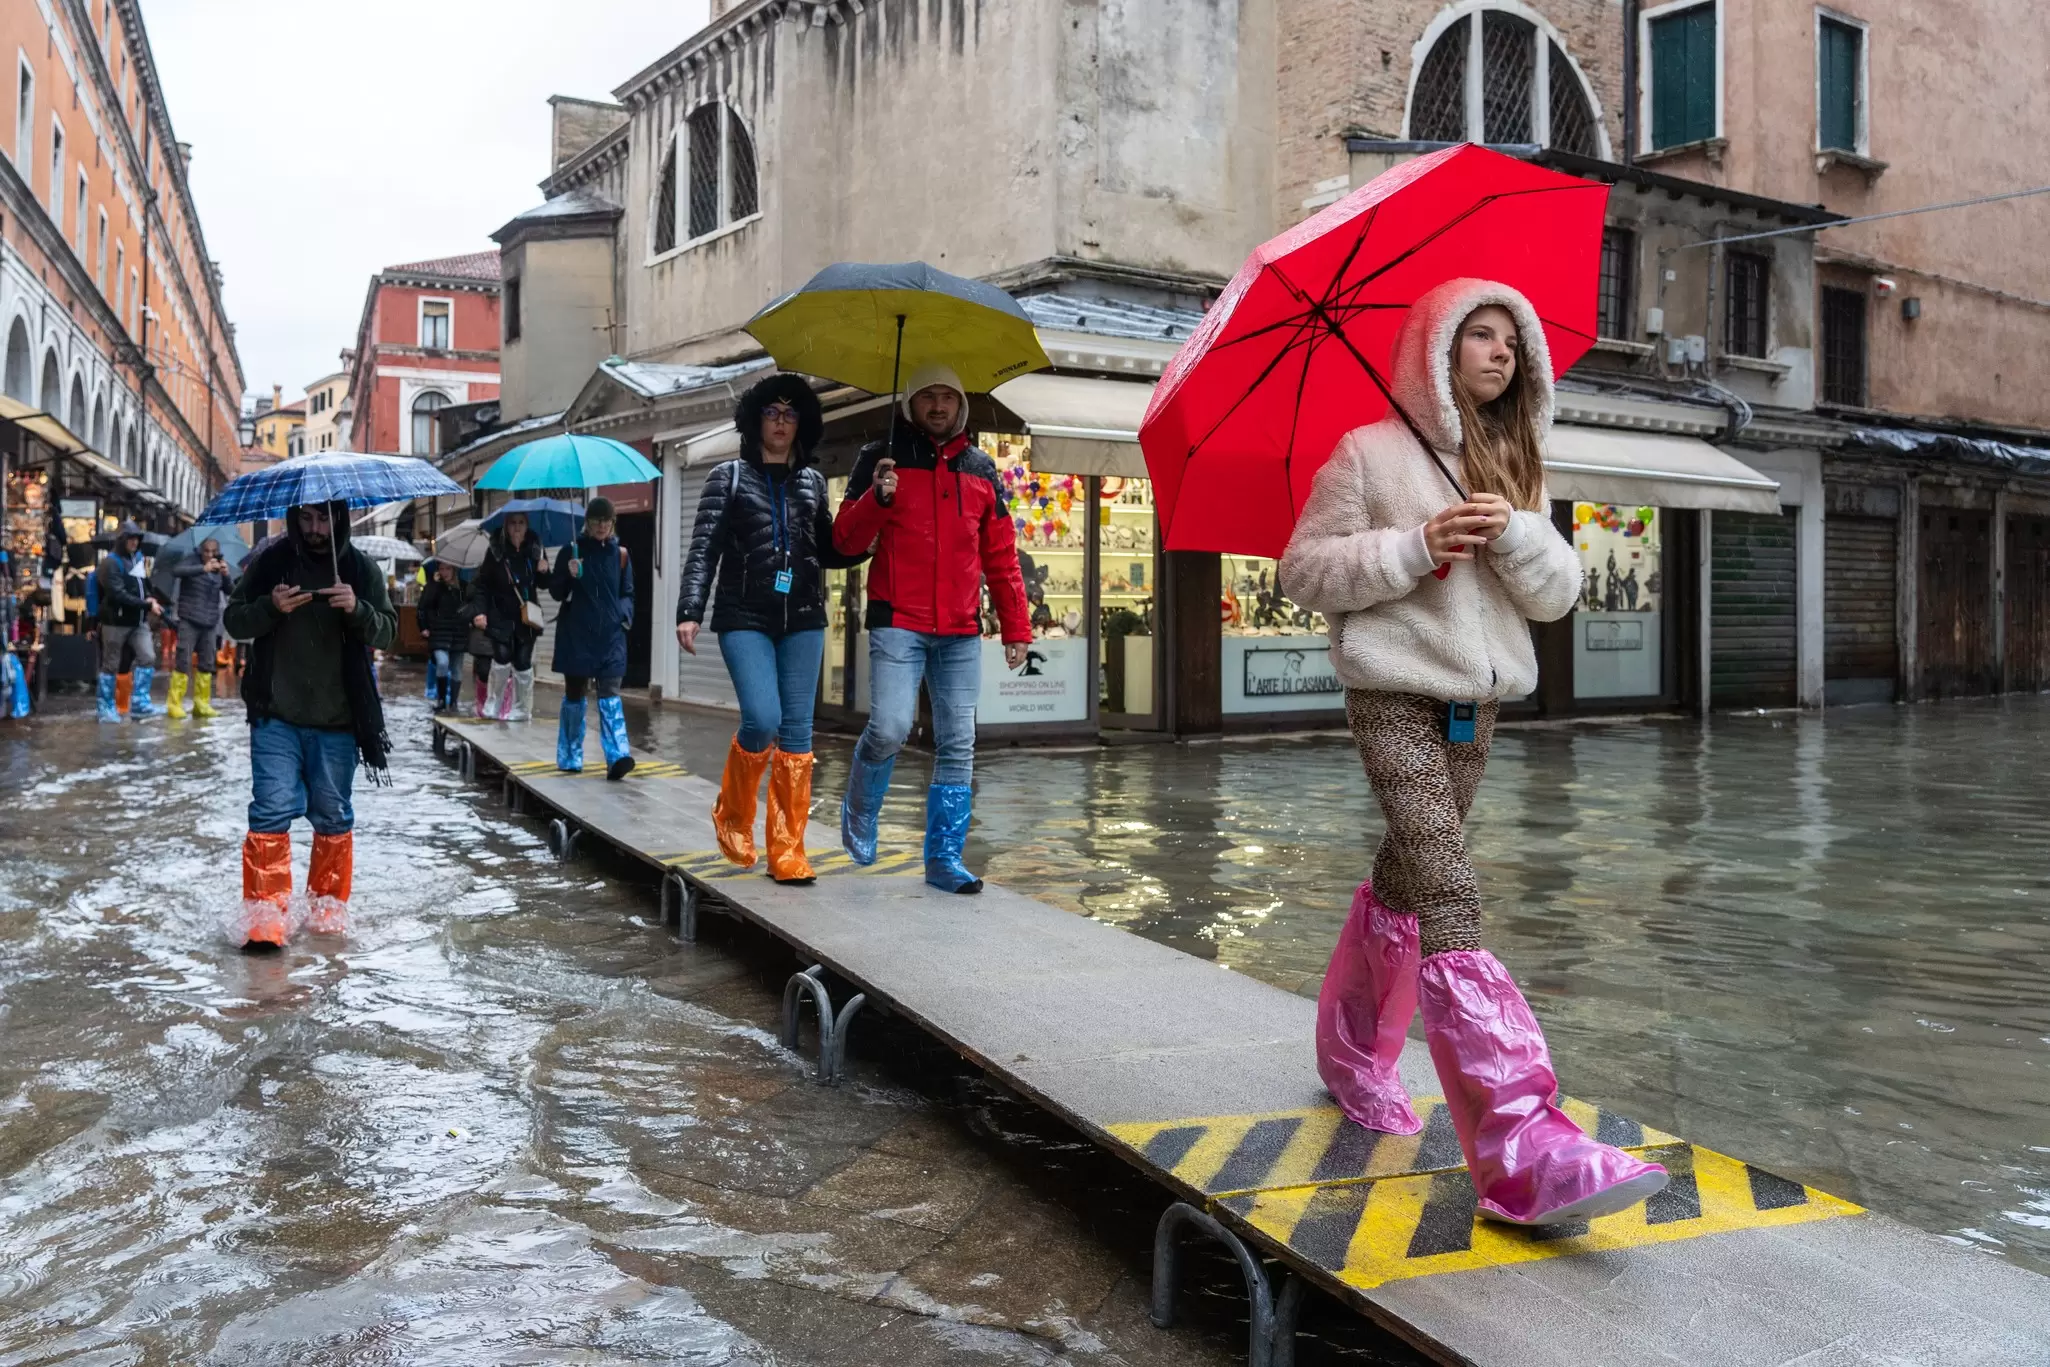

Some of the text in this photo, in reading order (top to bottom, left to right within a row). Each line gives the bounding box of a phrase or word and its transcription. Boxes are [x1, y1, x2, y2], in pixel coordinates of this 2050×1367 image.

[999, 679, 1065, 689] SHOPPING ON LINE
[1248, 676, 1280, 694] L'ARTE
[1282, 676, 1292, 693] DI
[1008, 703, 1056, 712] WORLD WIDE
